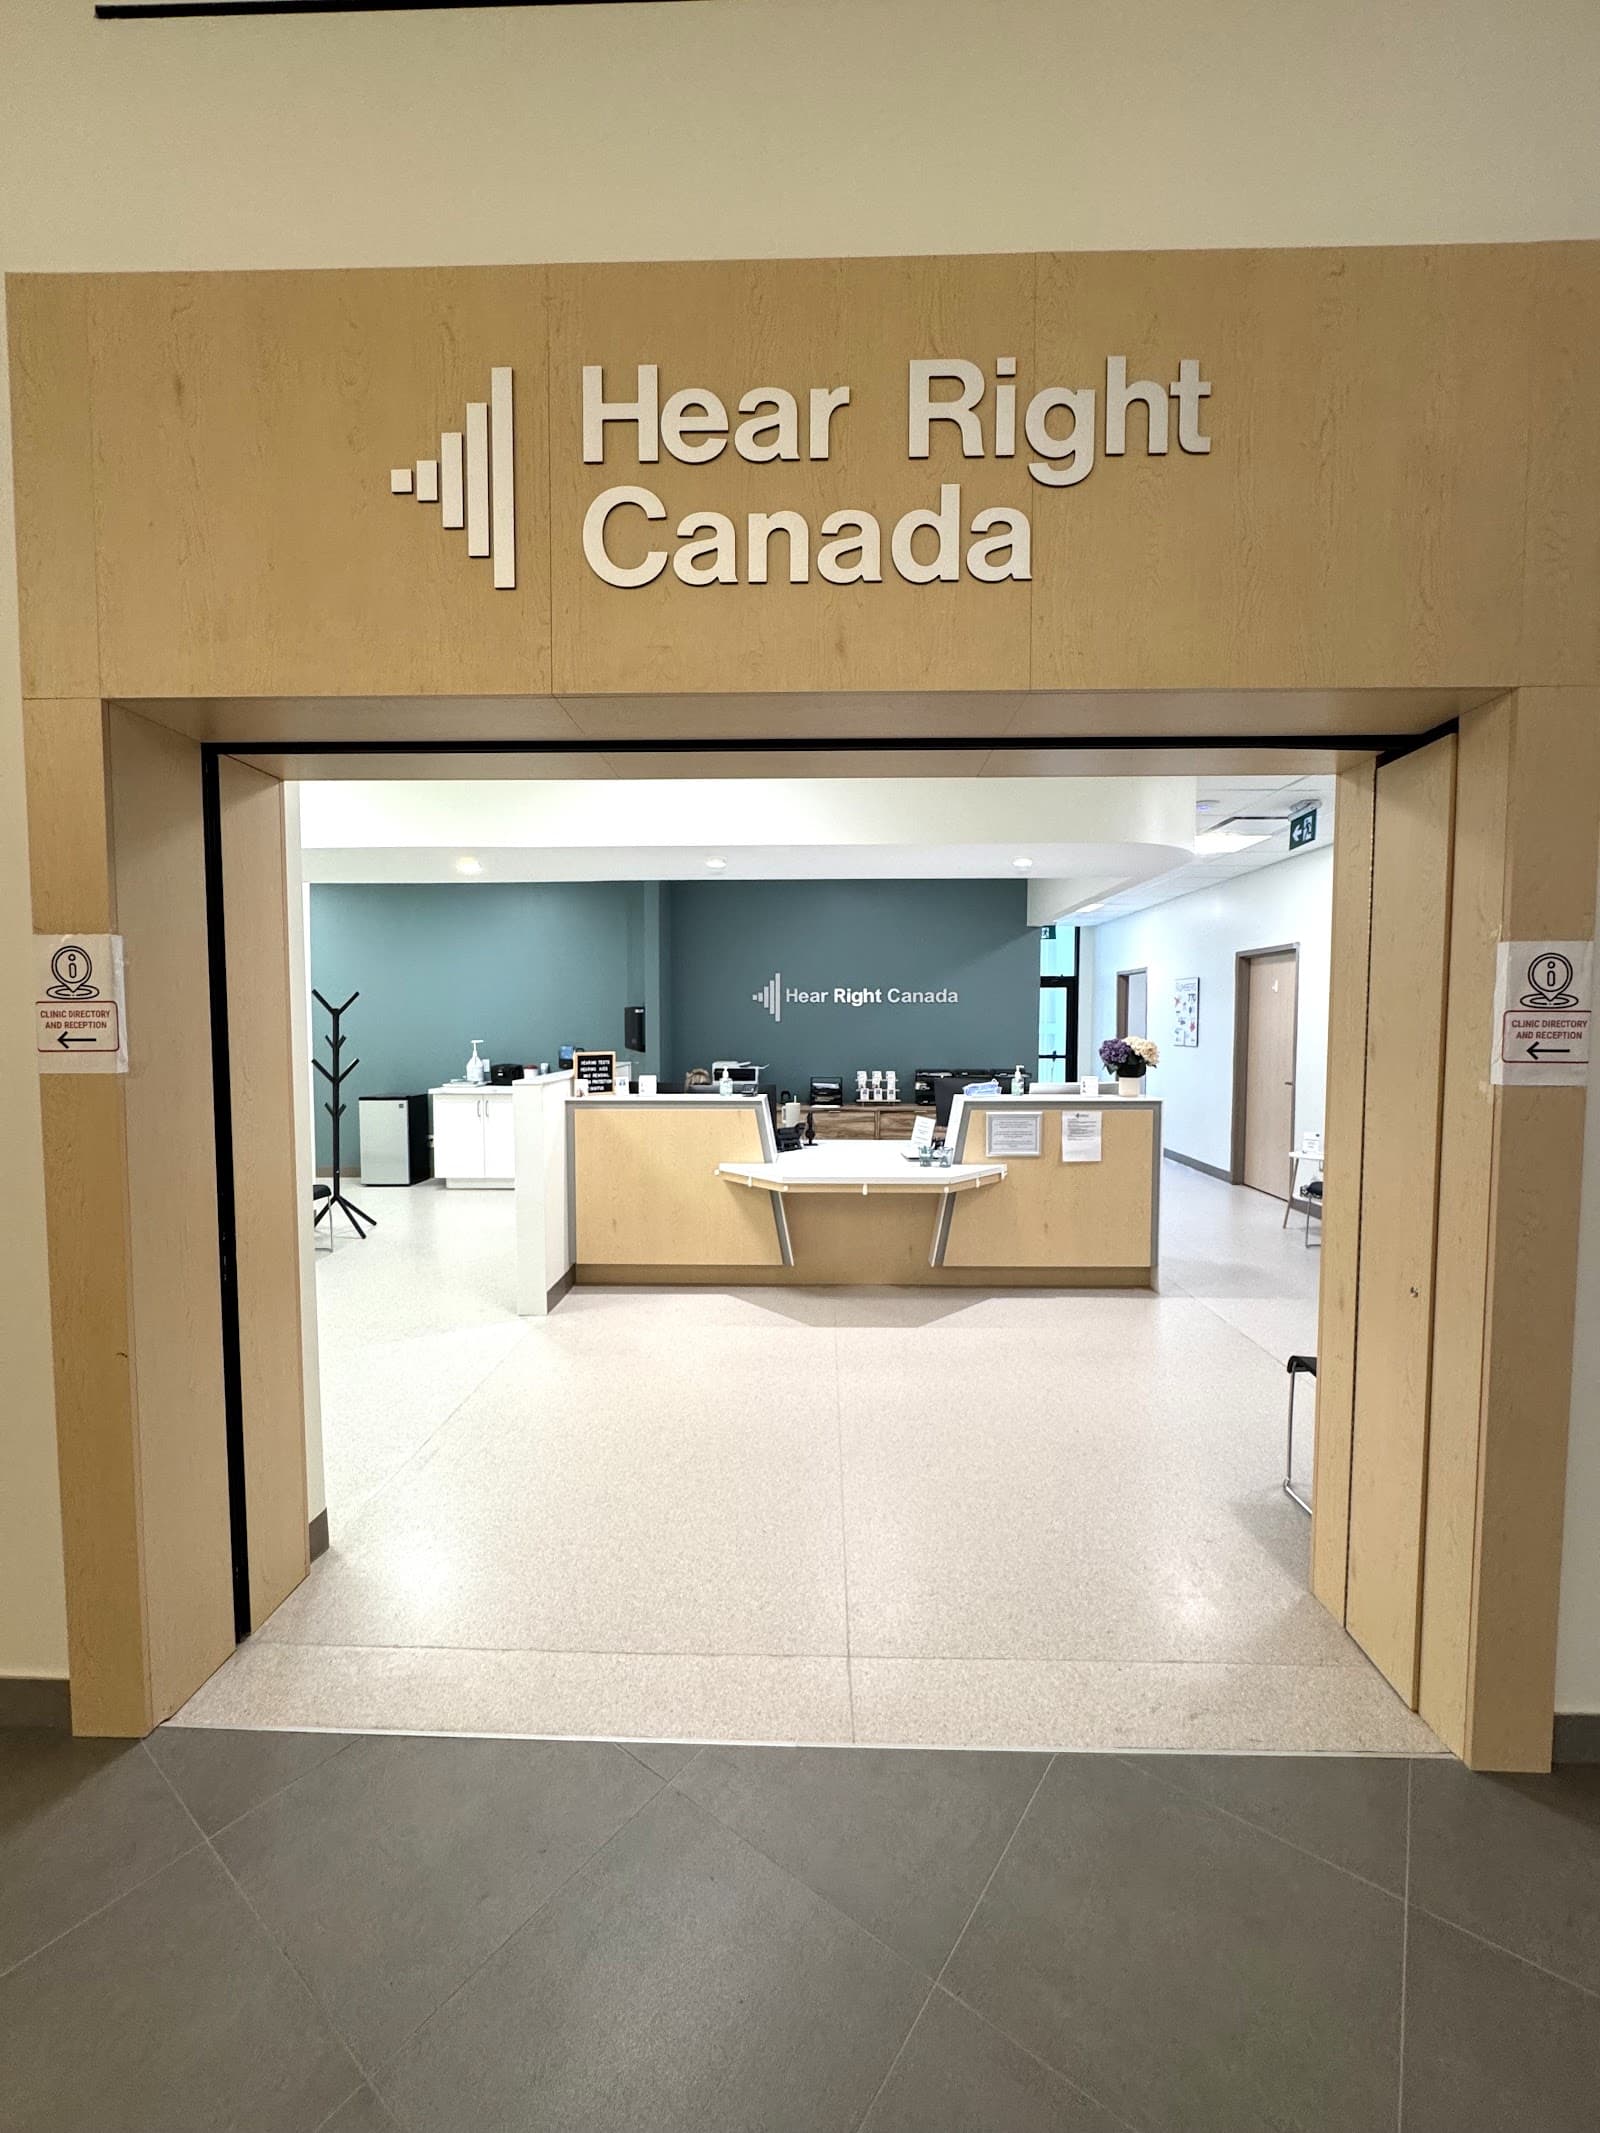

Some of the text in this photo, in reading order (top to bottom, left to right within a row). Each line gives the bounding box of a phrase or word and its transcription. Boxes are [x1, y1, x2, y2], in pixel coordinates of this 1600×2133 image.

[582, 355, 1212, 487] Hear Right
[582, 484, 1033, 589] Canada
[786, 988, 958, 1006] Hear Right Canada
[40, 1010, 111, 1018] CLINIC DIRECTORY
[45, 1021, 107, 1029] AND RECEPTION
[1511, 1019, 1588, 1028] CLINIC DIRECTORY
[1516, 1031, 1583, 1039] AND RECEPTION
